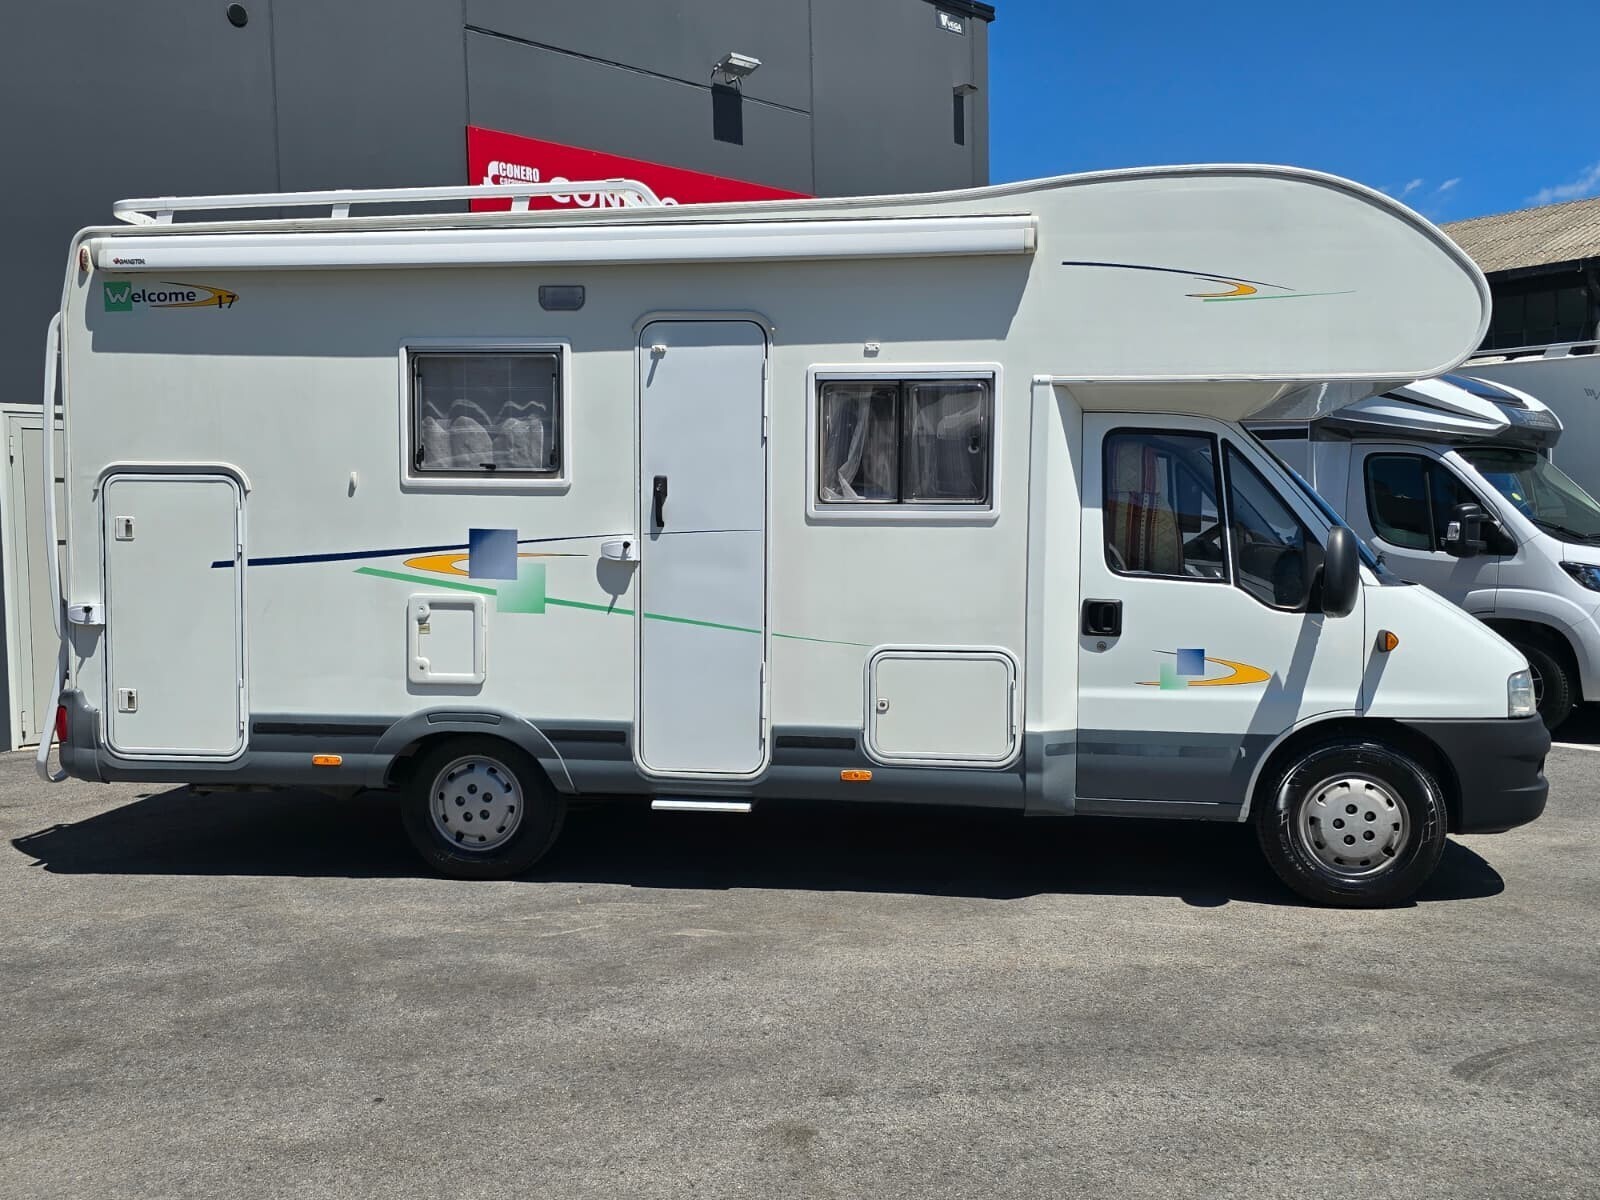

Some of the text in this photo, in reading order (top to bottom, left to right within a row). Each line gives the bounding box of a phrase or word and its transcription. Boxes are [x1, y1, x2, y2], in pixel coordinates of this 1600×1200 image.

[498, 161, 540, 183] CONERO
[106, 287, 236, 309] Welcome 17
